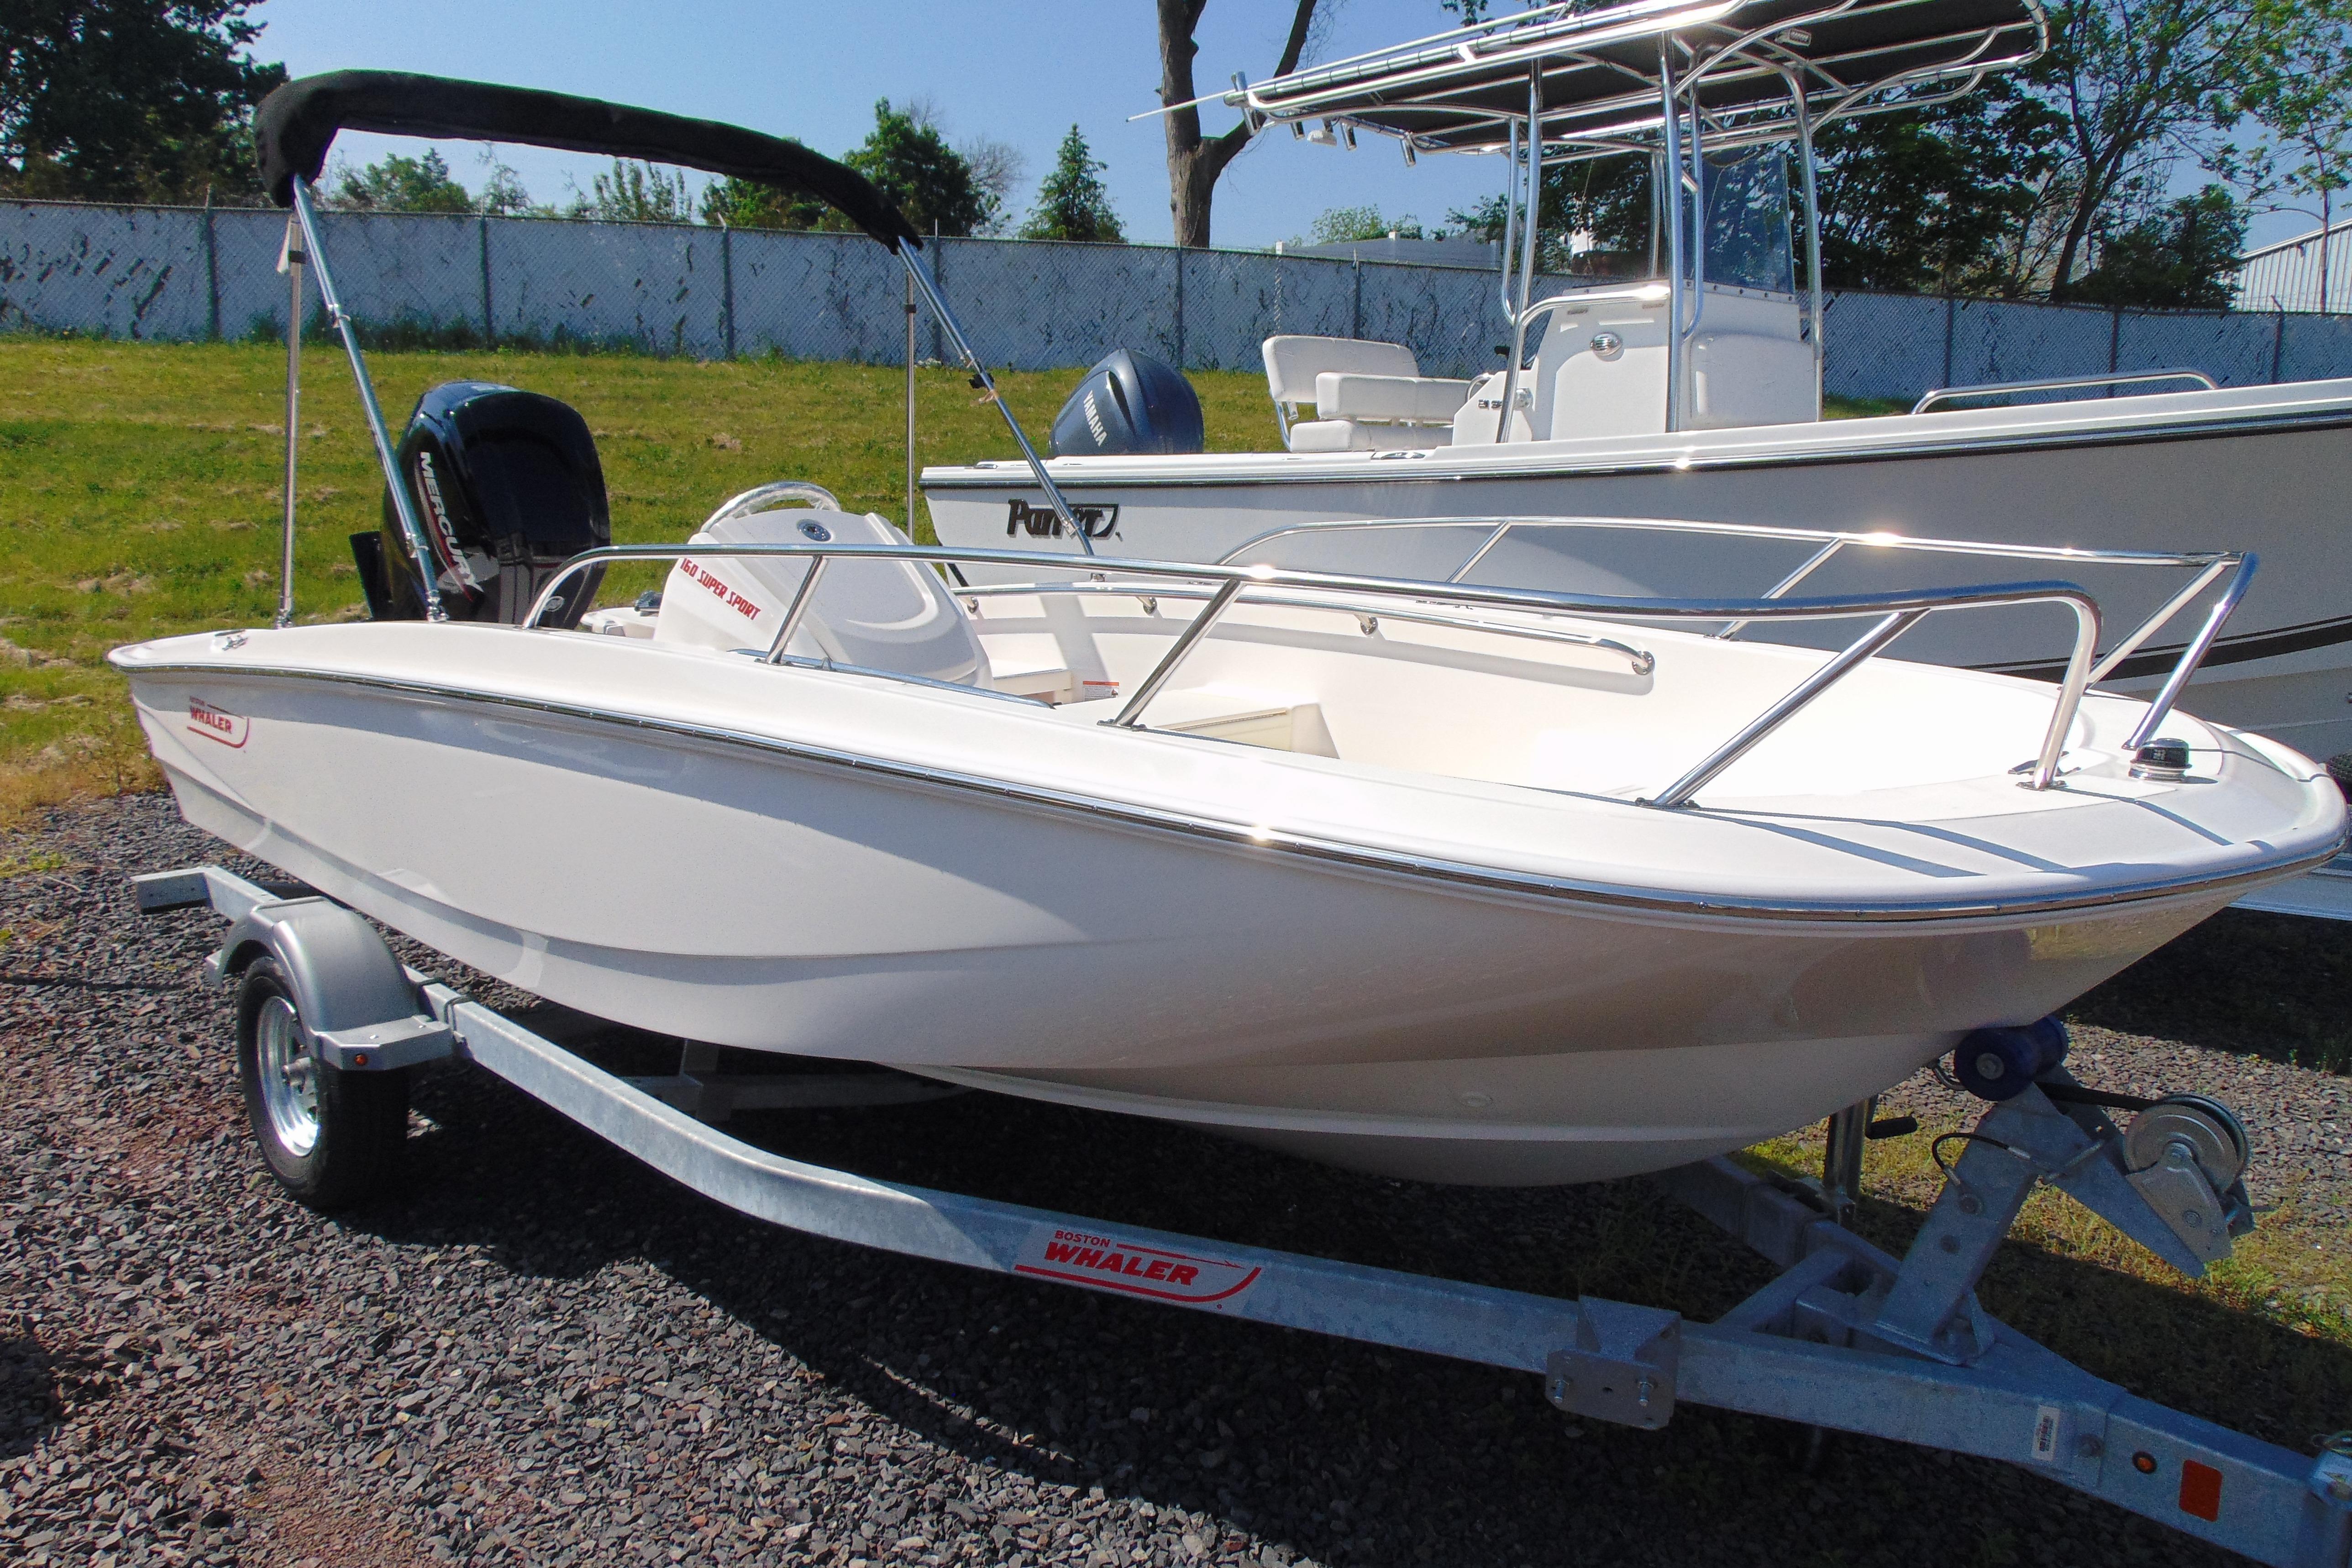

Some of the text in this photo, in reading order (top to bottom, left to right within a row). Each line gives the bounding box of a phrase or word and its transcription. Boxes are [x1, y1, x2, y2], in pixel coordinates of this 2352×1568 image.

[1083, 389, 1107, 447] YAMAHA
[420, 452, 484, 593] MERCURY
[680, 558, 761, 620] 160 SUPER SPORT
[1044, 1241, 1199, 1285] WHALER
[1055, 1230, 1111, 1248] BOSTON
